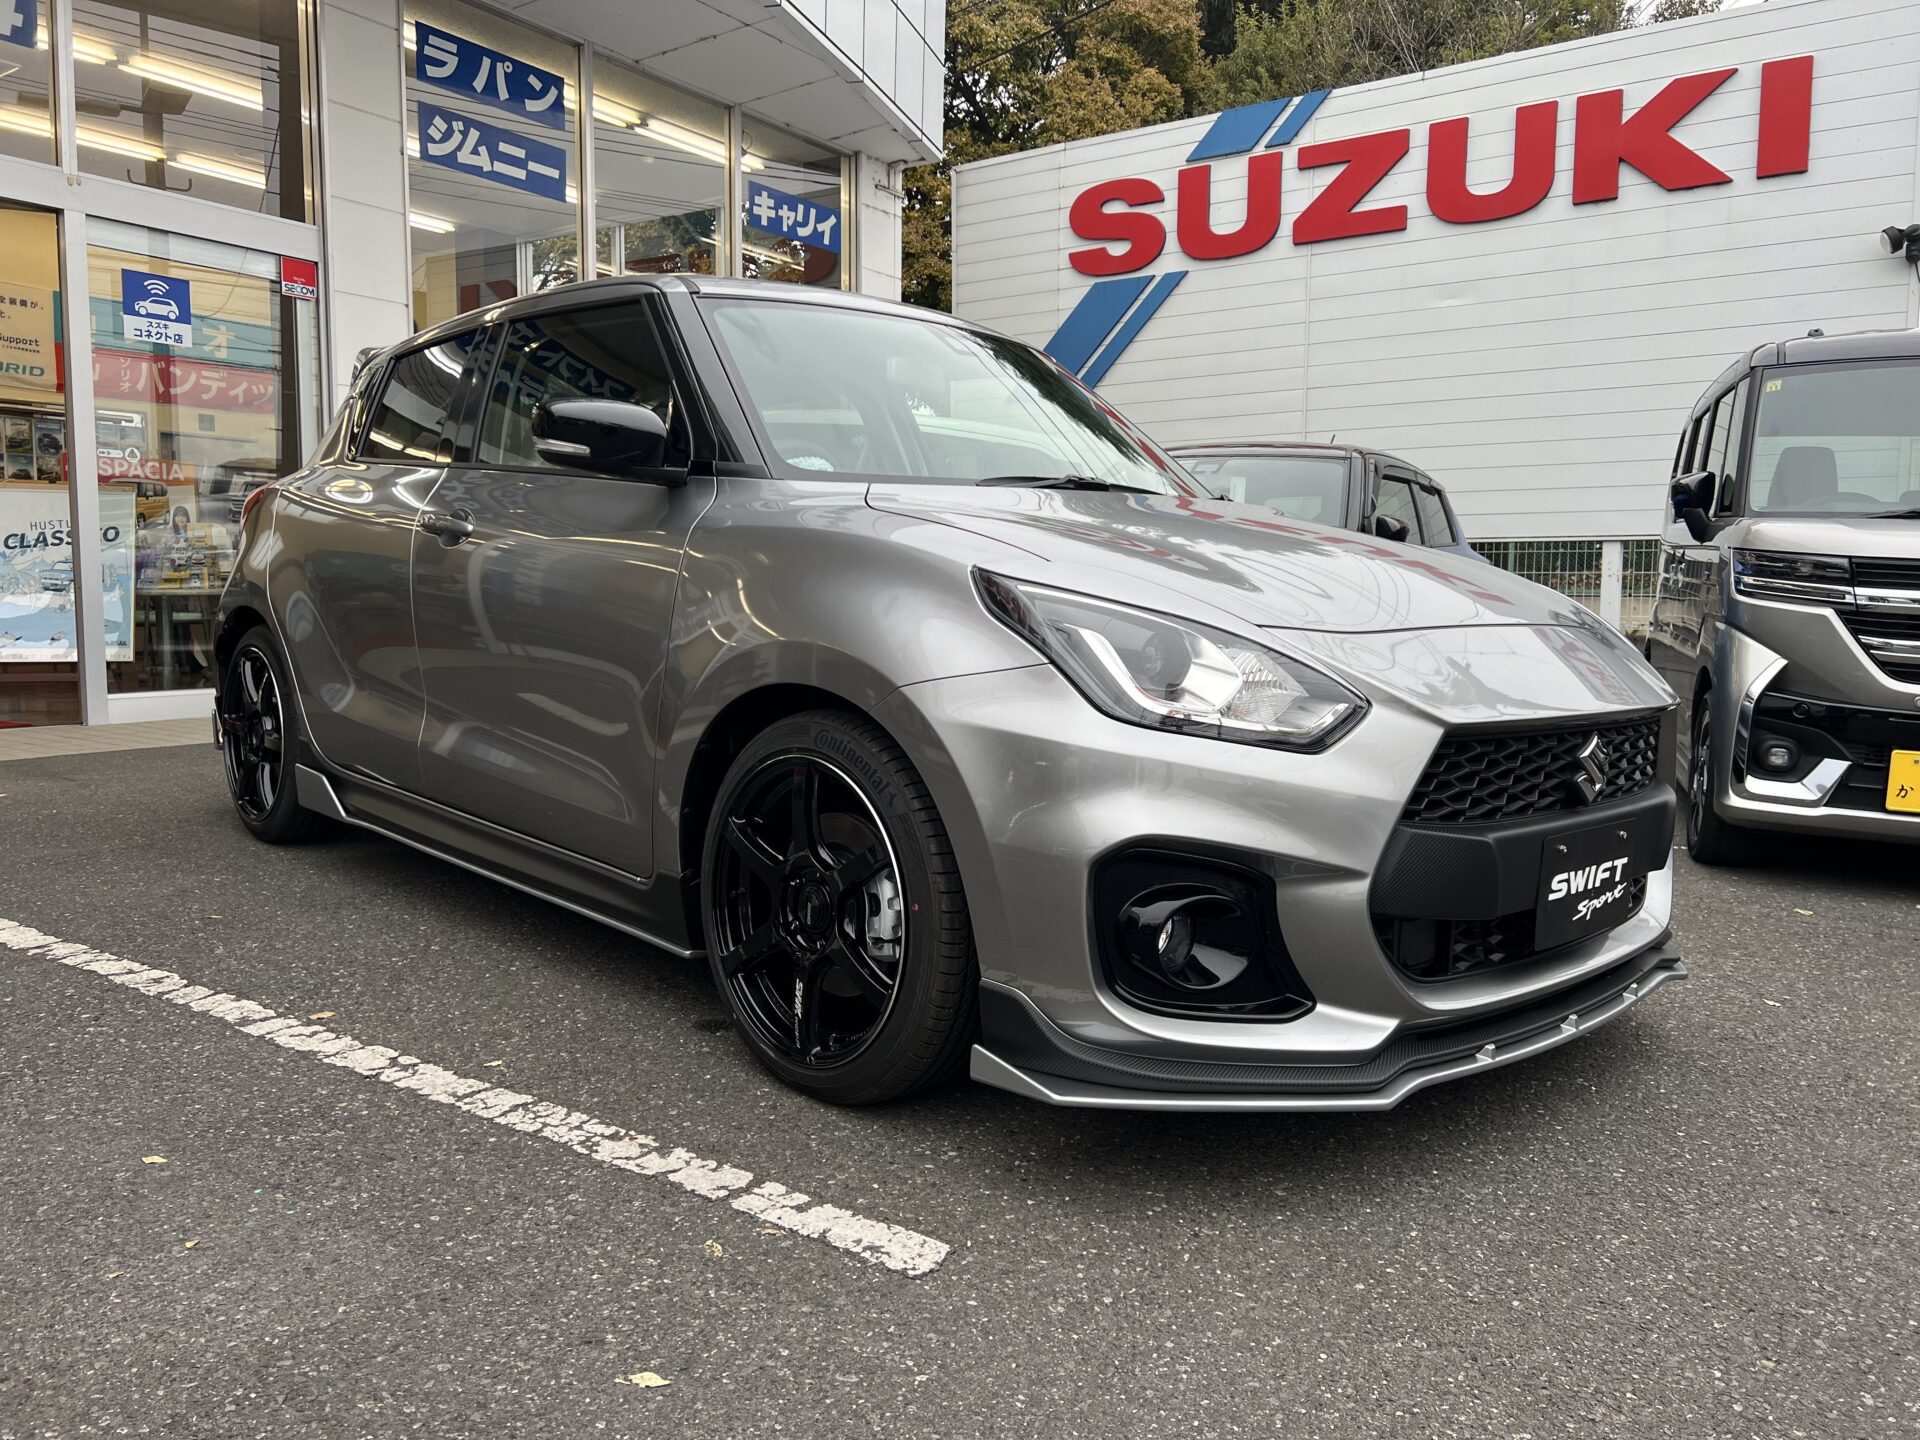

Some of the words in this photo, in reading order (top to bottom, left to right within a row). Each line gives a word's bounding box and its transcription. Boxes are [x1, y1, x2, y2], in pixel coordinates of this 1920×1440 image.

[424, 34, 559, 112] ラパン
[427, 114, 560, 181] ジムニー
[1068, 54, 1815, 277] SUZUKI
[752, 190, 837, 246] キャリイ
[284, 283, 315, 296] SECOM
[133, 328, 184, 344] コネクト店
[146, 320, 170, 330] スズキ
[0, 362, 45, 377] RID
[98, 458, 185, 481] SPACIA
[29, 518, 71, 531] HUSTL
[815, 729, 890, 795] Continental
[1896, 783, 1914, 799] か
[1548, 856, 1628, 901] SWIFT
[1572, 882, 1627, 921] Sport
